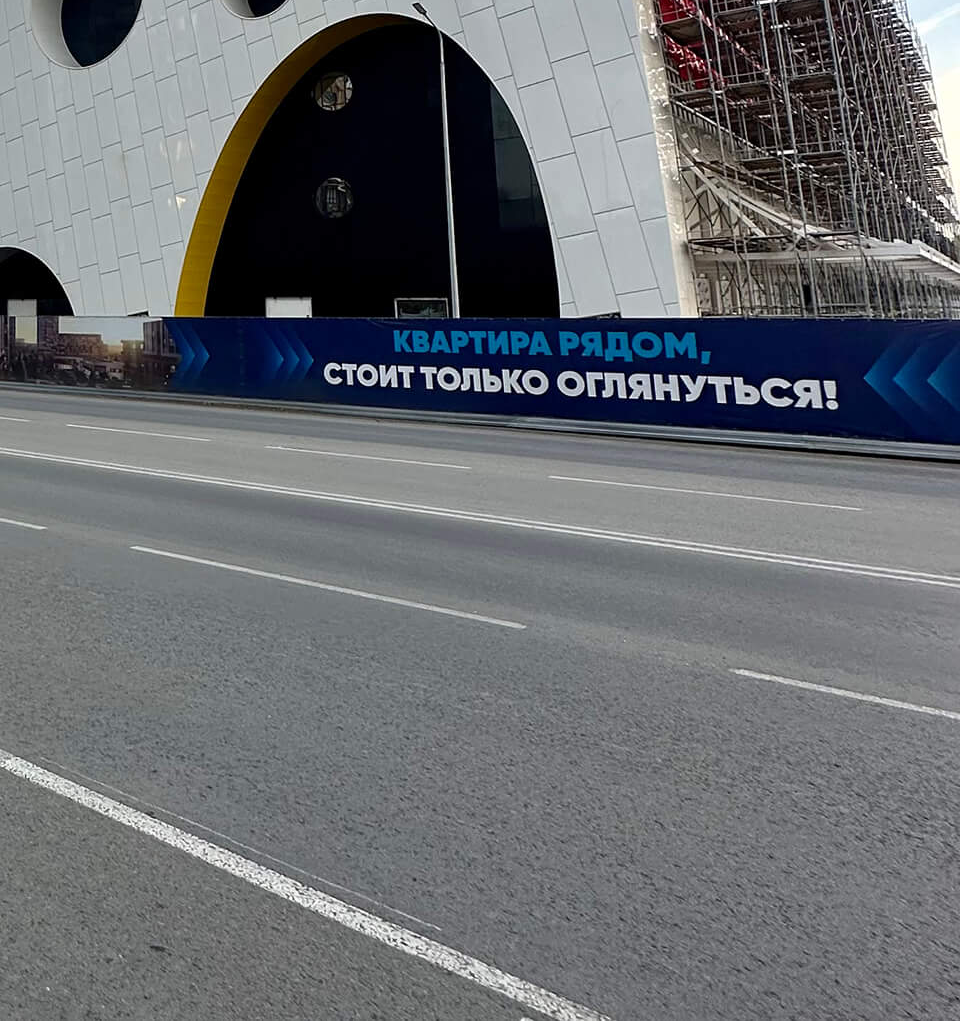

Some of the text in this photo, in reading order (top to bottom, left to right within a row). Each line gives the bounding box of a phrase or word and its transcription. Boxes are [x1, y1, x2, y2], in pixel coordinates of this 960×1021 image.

[393, 330, 711, 365] КВАРТИРА РЯДОМ,
[323, 362, 839, 411] СТОИТ ТОЛЬКО ОГЛЯНУТЬСЯ!
